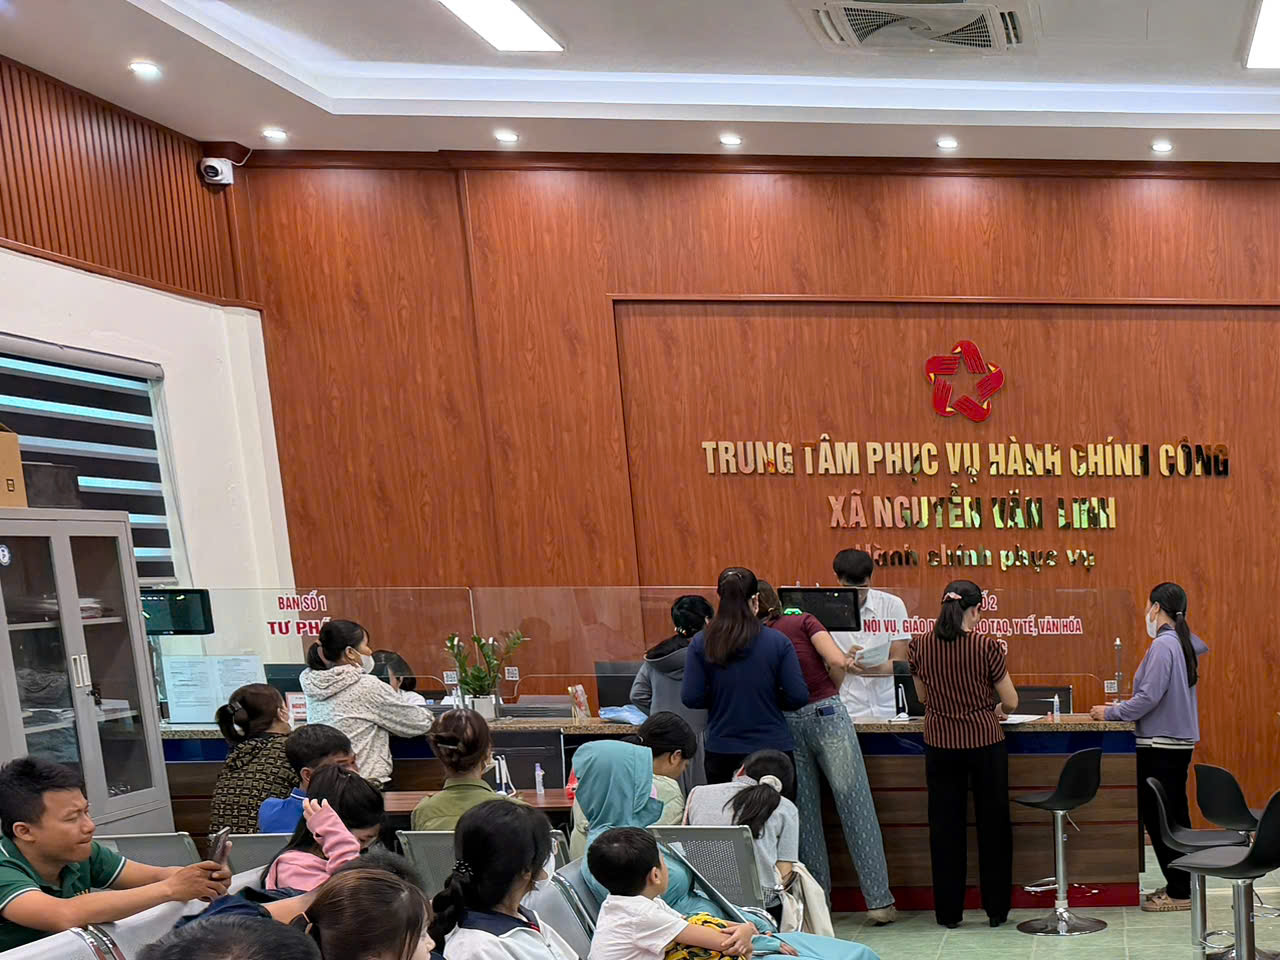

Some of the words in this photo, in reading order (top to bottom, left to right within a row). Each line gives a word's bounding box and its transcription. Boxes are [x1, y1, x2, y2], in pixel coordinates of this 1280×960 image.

[702, 441, 794, 475] TRUNG
[800, 433, 861, 475] TÂM
[866, 442, 939, 484] PHỤC
[946, 442, 981, 484] VỤ
[988, 435, 1062, 477] HÀNH
[1069, 435, 1150, 477] CHÍNH
[1159, 435, 1229, 478] CÔNG
[828, 488, 867, 529] XÃ
[874, 482, 982, 529] NGUYỄN
[991, 488, 1044, 529] VĂN
[1057, 497, 1116, 529] LINH
[927, 543, 992, 567] chính
[999, 543, 1057, 573] phục
[1066, 549, 1096, 573] vụ
[302, 590, 319, 611] SỐ
[319, 595, 327, 611] 1
[989, 595, 998, 611] 2
[267, 620, 291, 636] TƯ
[295, 617, 331, 637] PH
[863, 616, 881, 636] NỘI
[883, 618, 900, 636] VỤ,
[902, 616, 927, 634] GIÁO
[1012, 618, 1021, 634] Y
[1039, 616, 1060, 634] VĂN
[1061, 615, 1083, 634] HÓA
